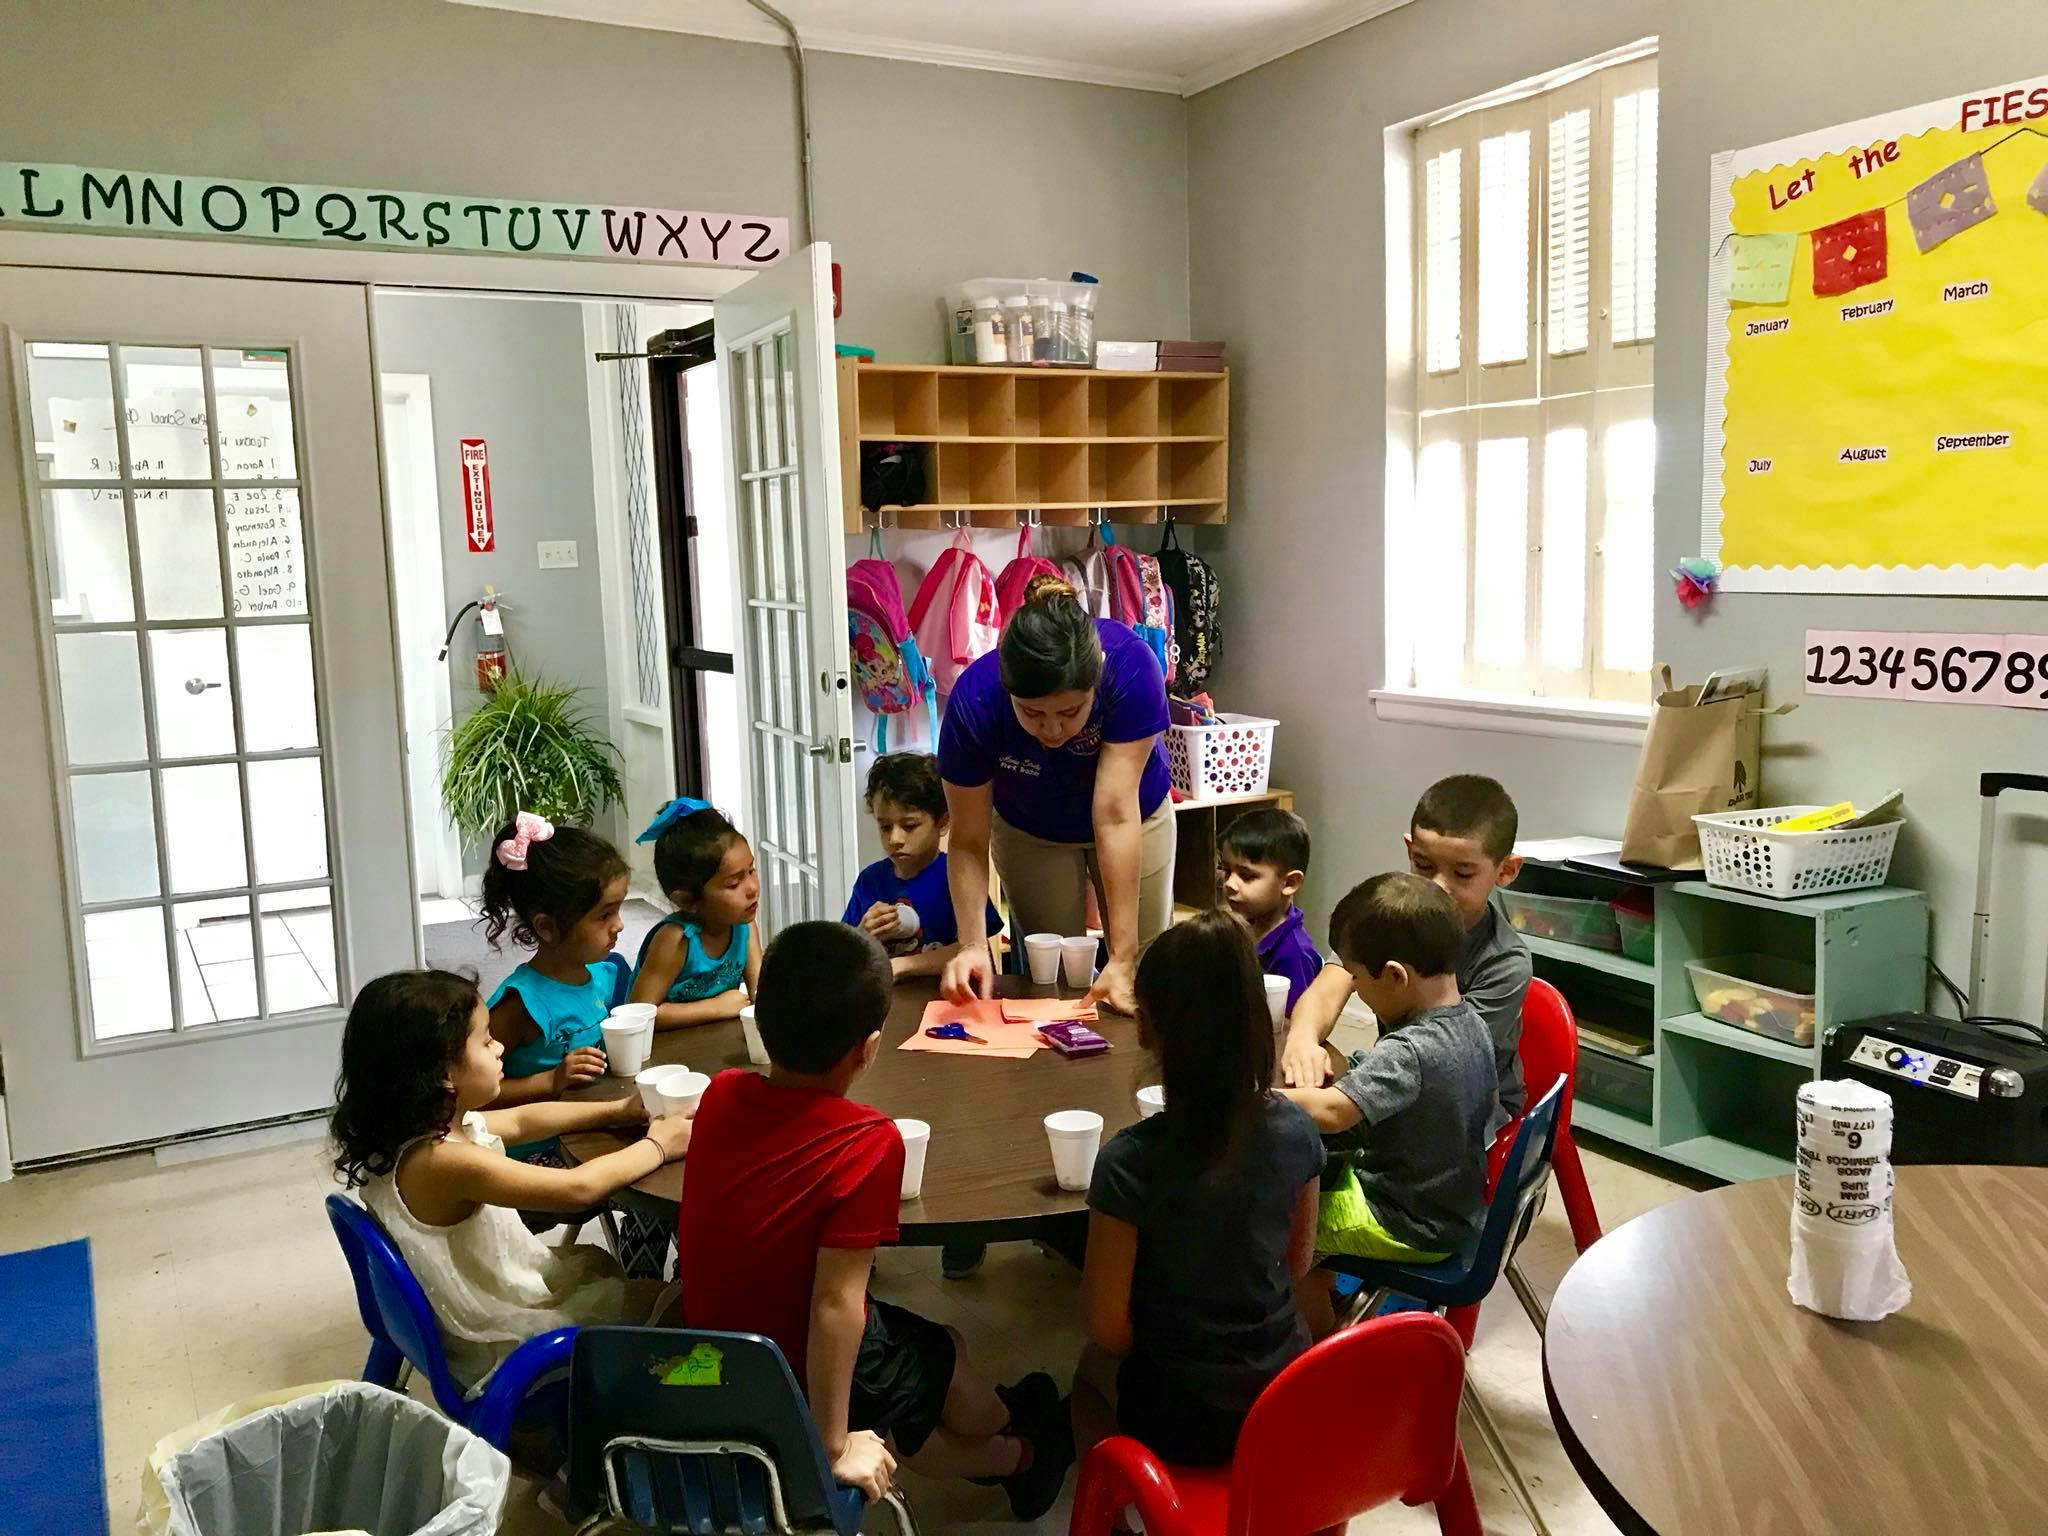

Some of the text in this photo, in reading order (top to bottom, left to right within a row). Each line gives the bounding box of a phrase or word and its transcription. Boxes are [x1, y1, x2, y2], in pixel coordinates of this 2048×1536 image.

[1769, 87, 2048, 211] Let the FIES
[1746, 281, 1989, 337] January February March
[465, 450, 485, 460] FIRE
[1748, 433, 2009, 473] July August September
[472, 464, 486, 544] EXTINGUISHER
[1847, 1132, 1862, 1149] 6
[1833, 1208, 1876, 1219] DART
